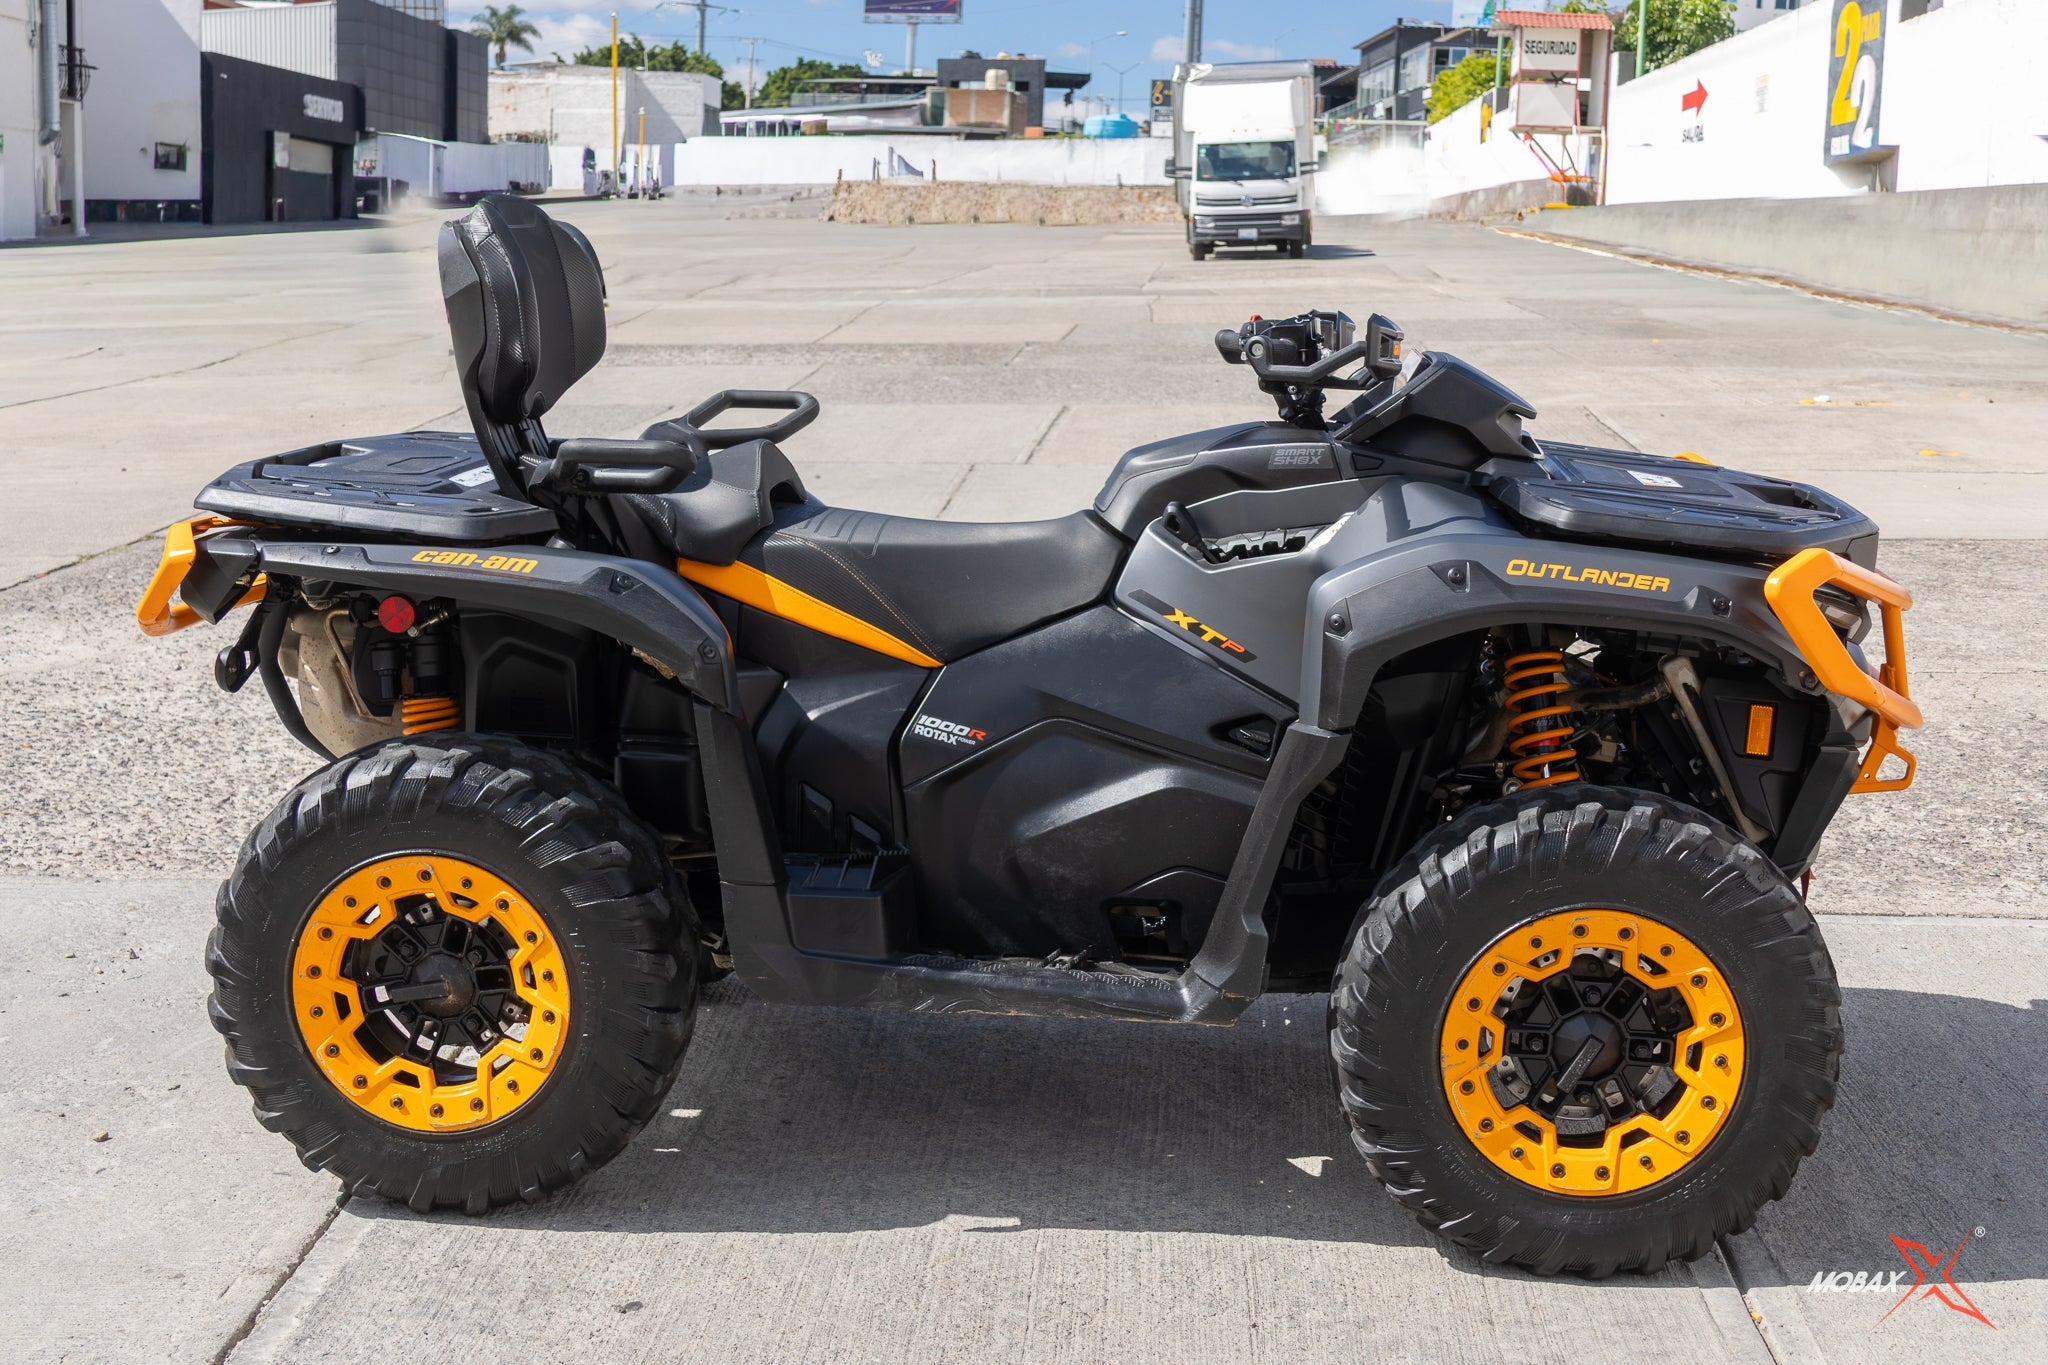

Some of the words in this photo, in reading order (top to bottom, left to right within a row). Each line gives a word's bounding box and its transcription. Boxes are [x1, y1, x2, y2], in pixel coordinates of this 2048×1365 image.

[1524, 39, 1577, 55] SEGURIDAD
[1273, 456, 1321, 465] SHOX
[1275, 448, 1325, 457] SMART
[411, 550, 539, 574] can-am
[1505, 558, 1671, 593] OUTLANDER
[914, 724, 958, 746] ROTAX
[957, 737, 976, 746] POWER
[918, 714, 987, 741] 1000R
